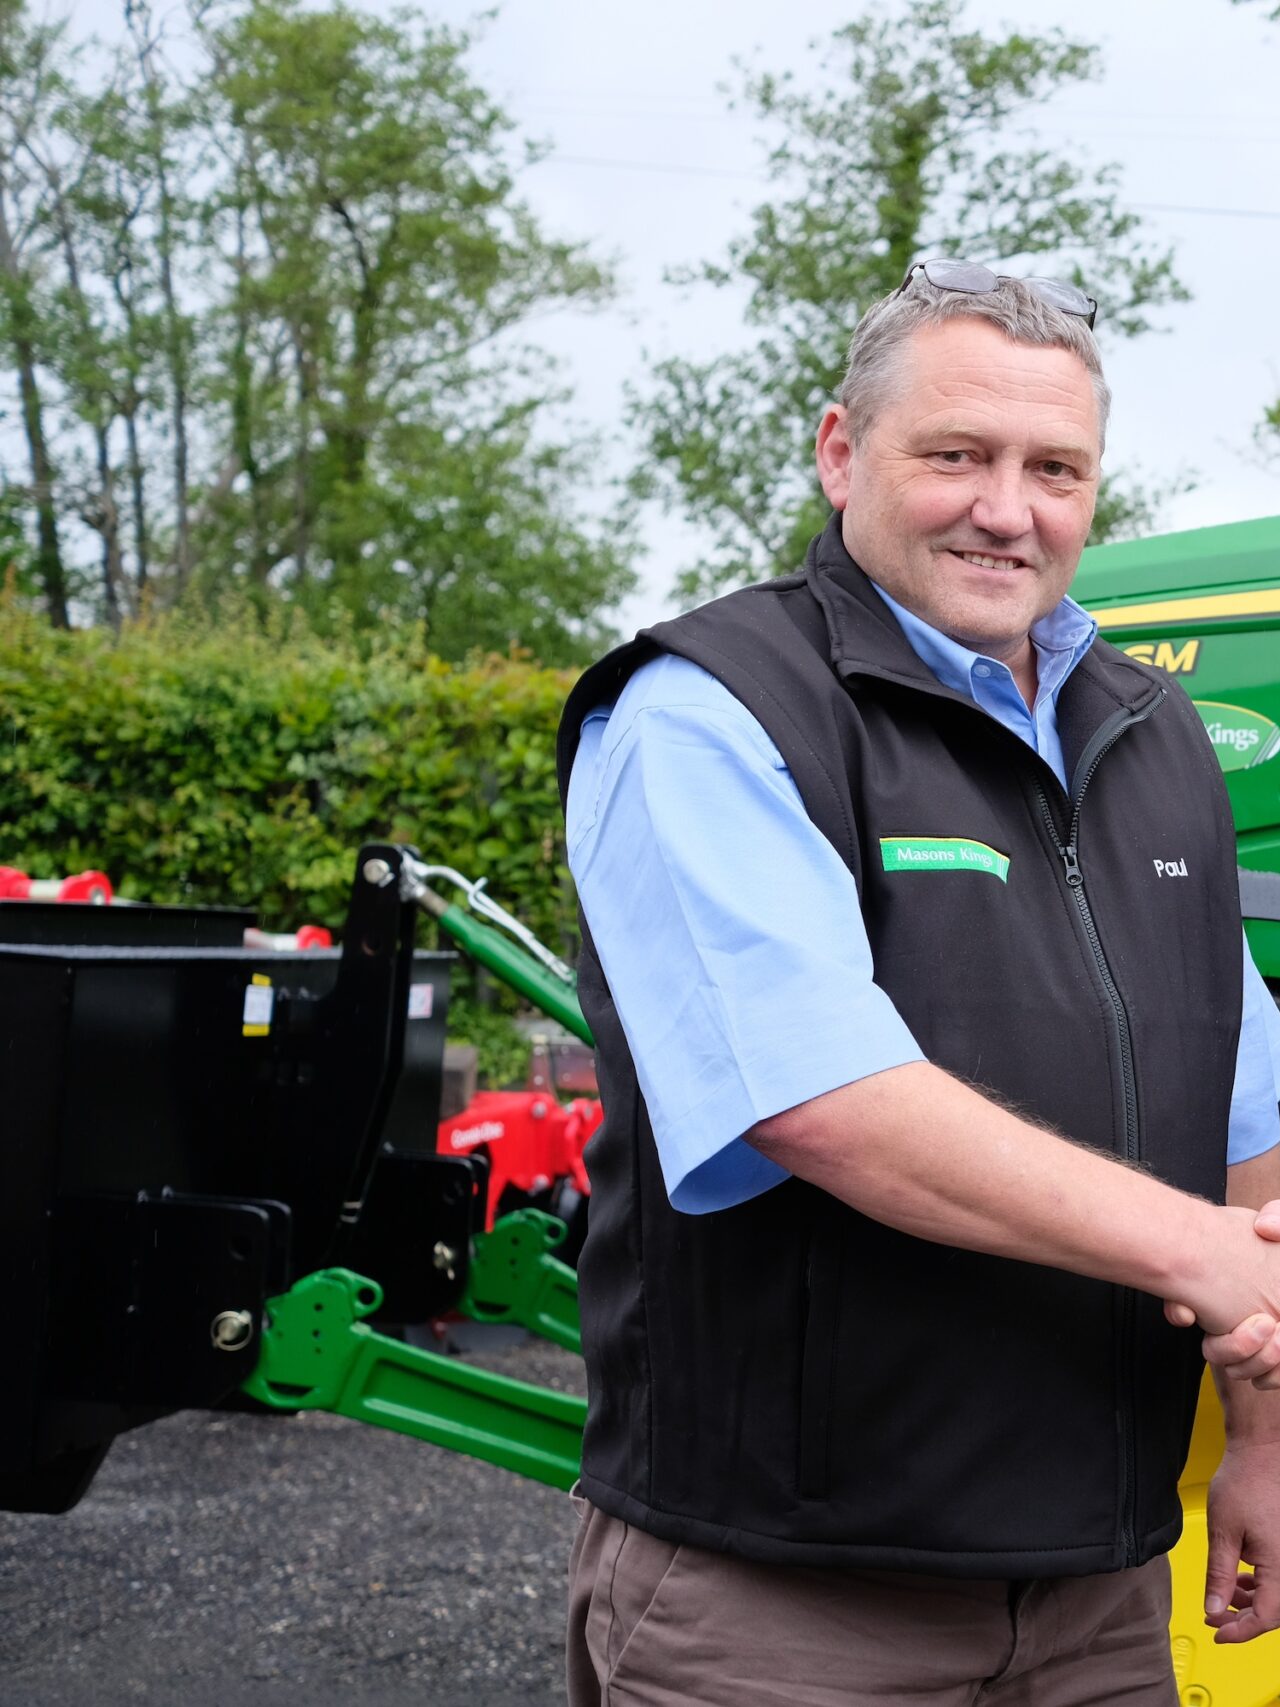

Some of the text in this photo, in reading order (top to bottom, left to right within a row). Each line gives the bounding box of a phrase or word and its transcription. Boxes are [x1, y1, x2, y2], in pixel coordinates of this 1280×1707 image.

[896, 847, 993, 868] Masons Kings
[1153, 857, 1189, 878] Paul
